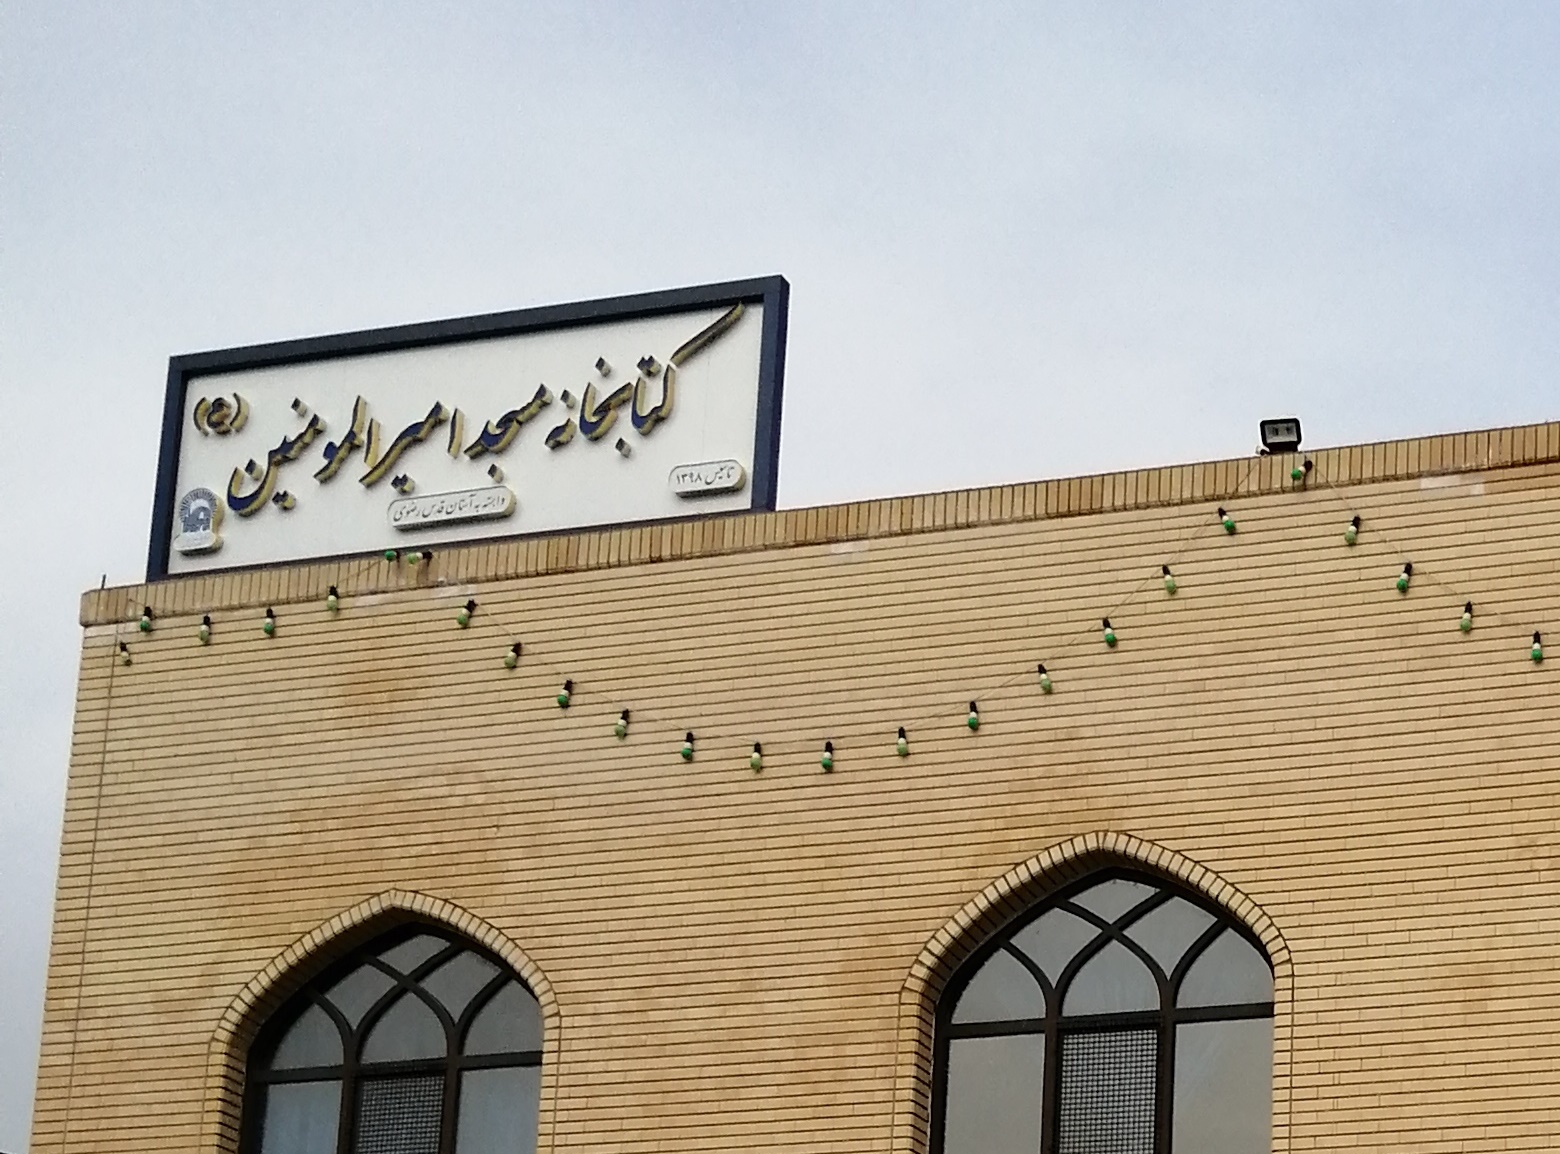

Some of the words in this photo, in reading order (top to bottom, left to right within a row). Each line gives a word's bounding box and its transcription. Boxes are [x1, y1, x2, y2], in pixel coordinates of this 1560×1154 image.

[545, 302, 745, 459] کتابخانه
[463, 383, 552, 482] مسجد
[421, 501, 445, 518] قدس
[445, 494, 476, 515] آستان
[482, 494, 505, 509] وابسته
[393, 502, 421, 522] رضوی
